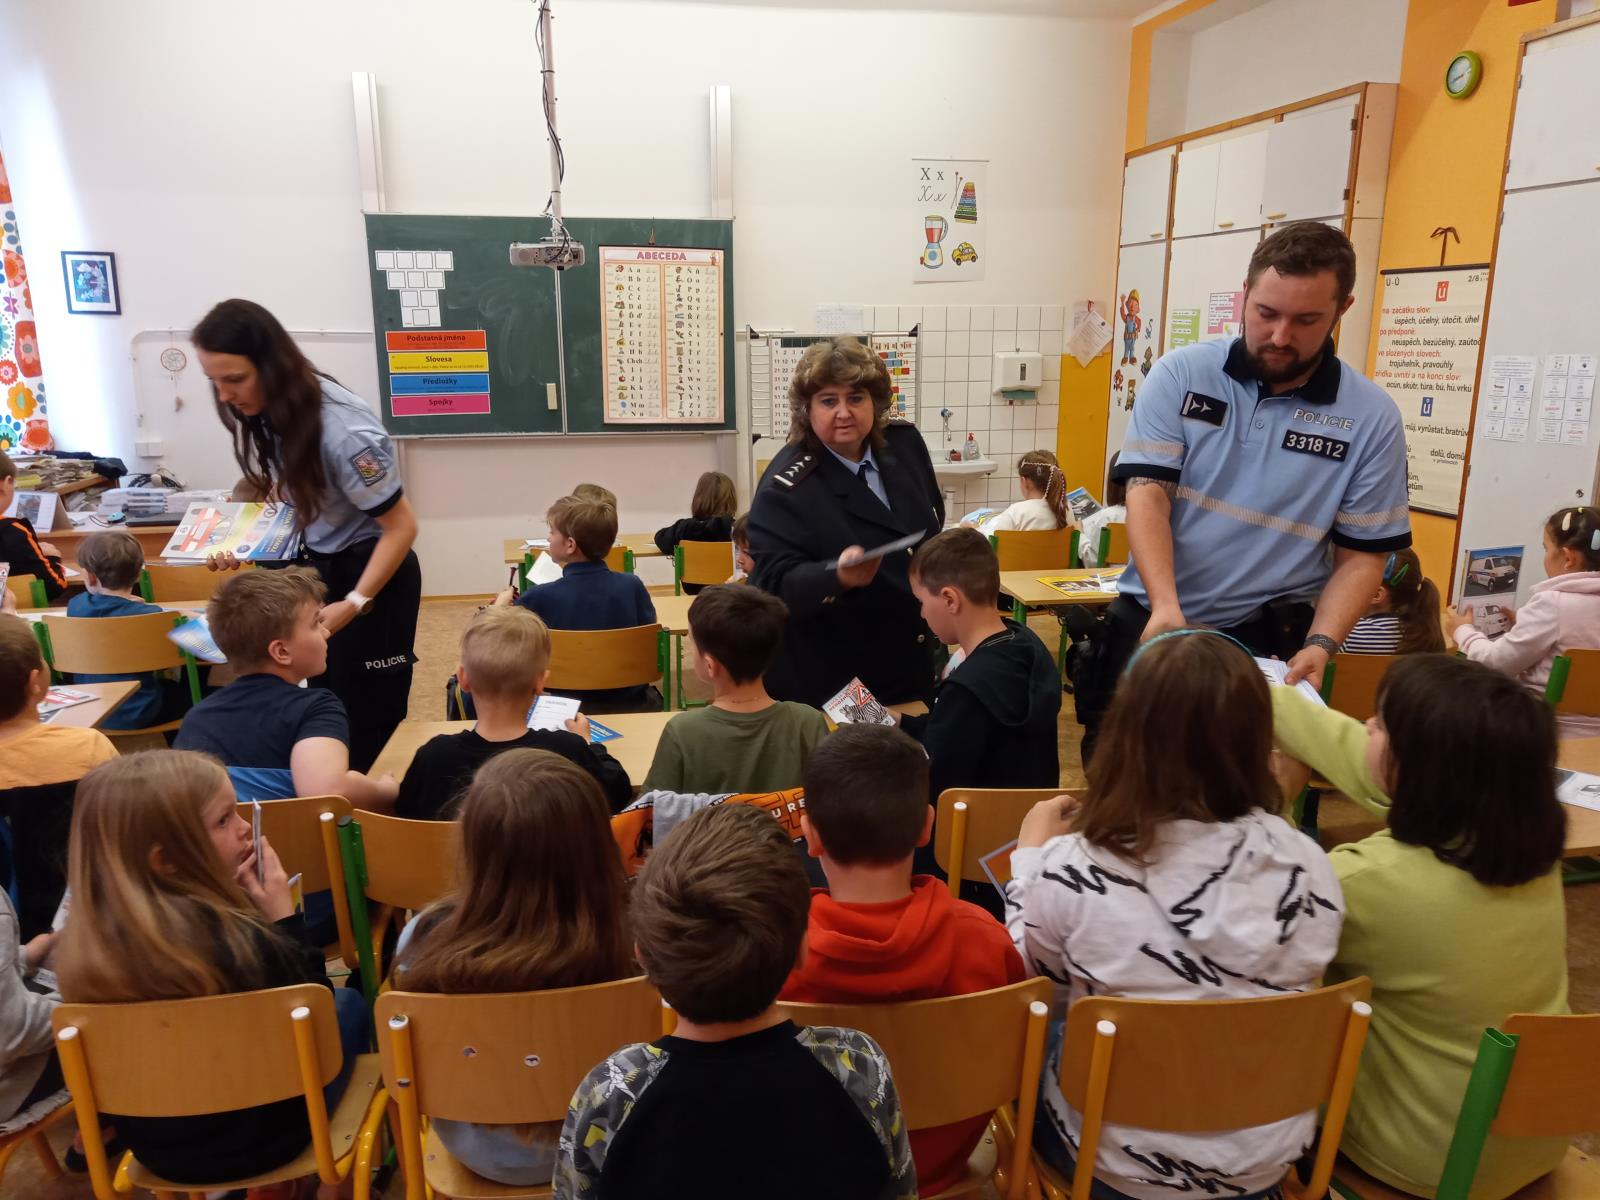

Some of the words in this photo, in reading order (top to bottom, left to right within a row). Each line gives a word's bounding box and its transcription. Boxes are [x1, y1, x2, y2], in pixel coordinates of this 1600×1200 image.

[920, 168, 931, 180] X
[937, 171, 944, 180] x
[636, 252, 687, 260] ABECEDA
[1293, 408, 1354, 430] POLICIE
[1286, 434, 1344, 458] 331812
[365, 655, 407, 669] POLICIE
